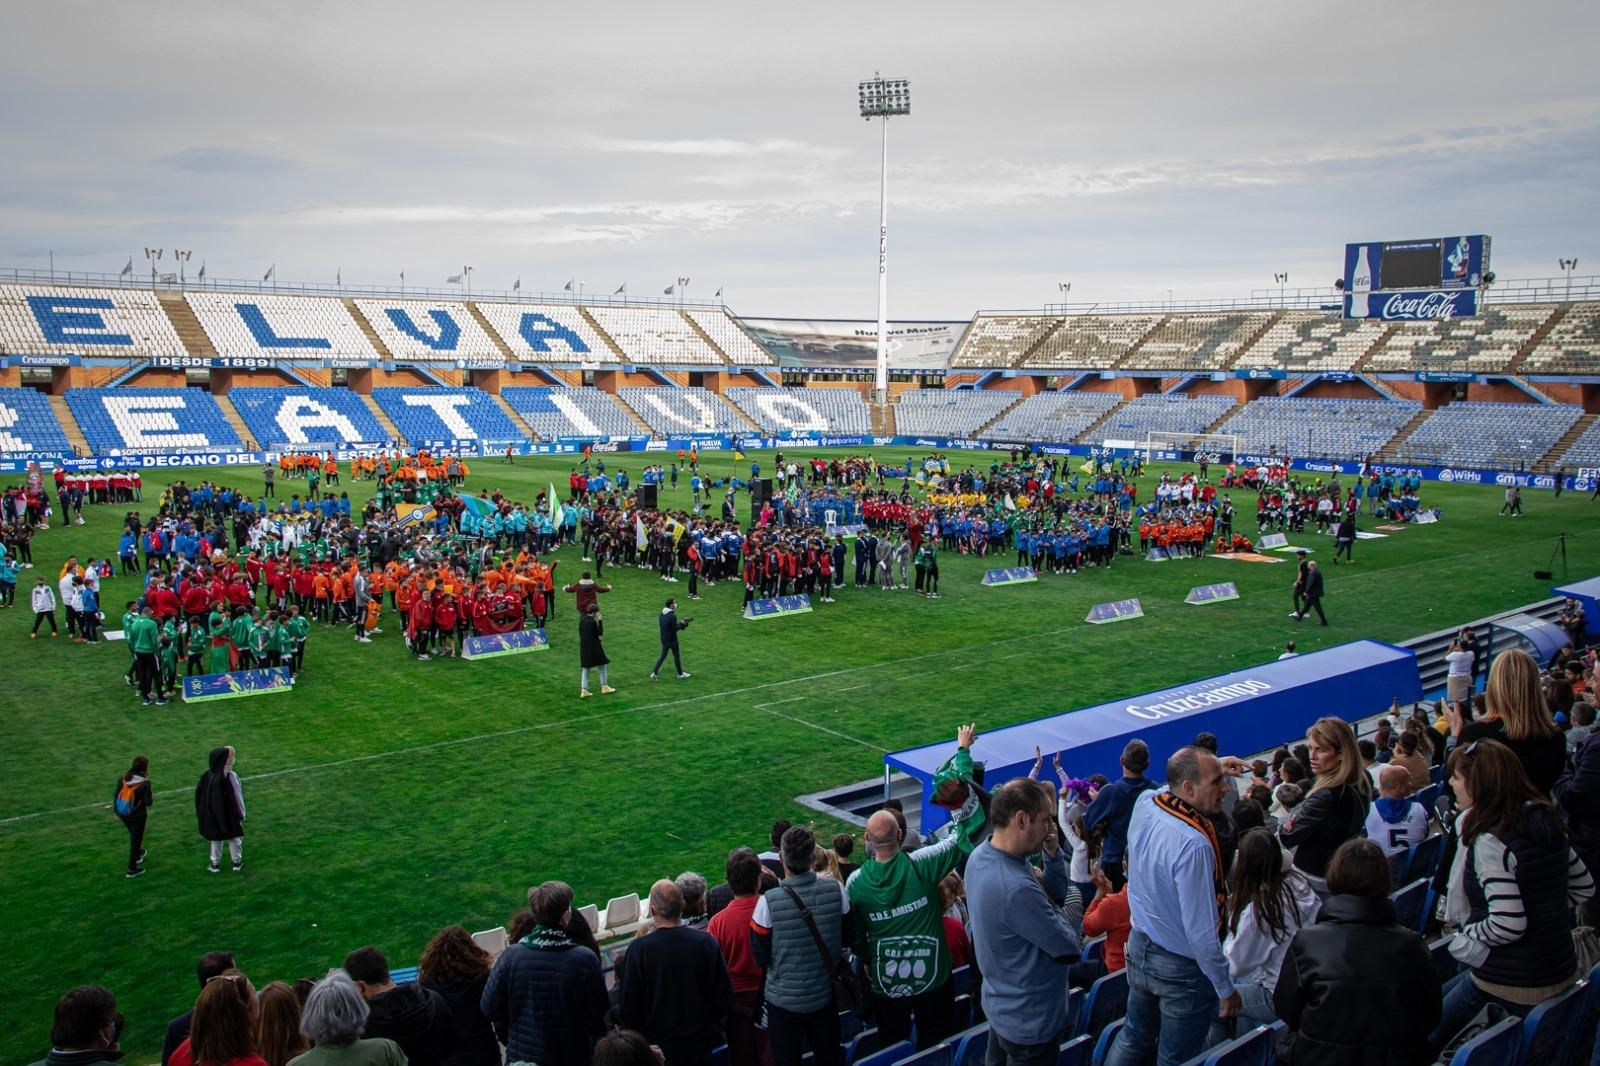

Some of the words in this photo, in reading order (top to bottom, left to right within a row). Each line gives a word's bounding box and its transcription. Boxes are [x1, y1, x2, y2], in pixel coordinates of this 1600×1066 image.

[879, 226, 887, 273] grupo
[1383, 292, 1461, 319] Coca-Cola
[906, 326, 950, 334] Motor
[22, 356, 70, 365] Cruzcampo
[160, 357, 212, 367] DESDE
[220, 358, 269, 368] 1889
[62, 457, 98, 466] Carrefour
[143, 455, 221, 466] DECANO
[226, 453, 260, 464] DEL
[1454, 470, 1482, 482] WiHu
[1126, 679, 1271, 720] Cruzcampo
[1389, 829, 1409, 848] 5
[869, 910, 892, 922] C.D.E.
[891, 896, 929, 919] AMISTAD
